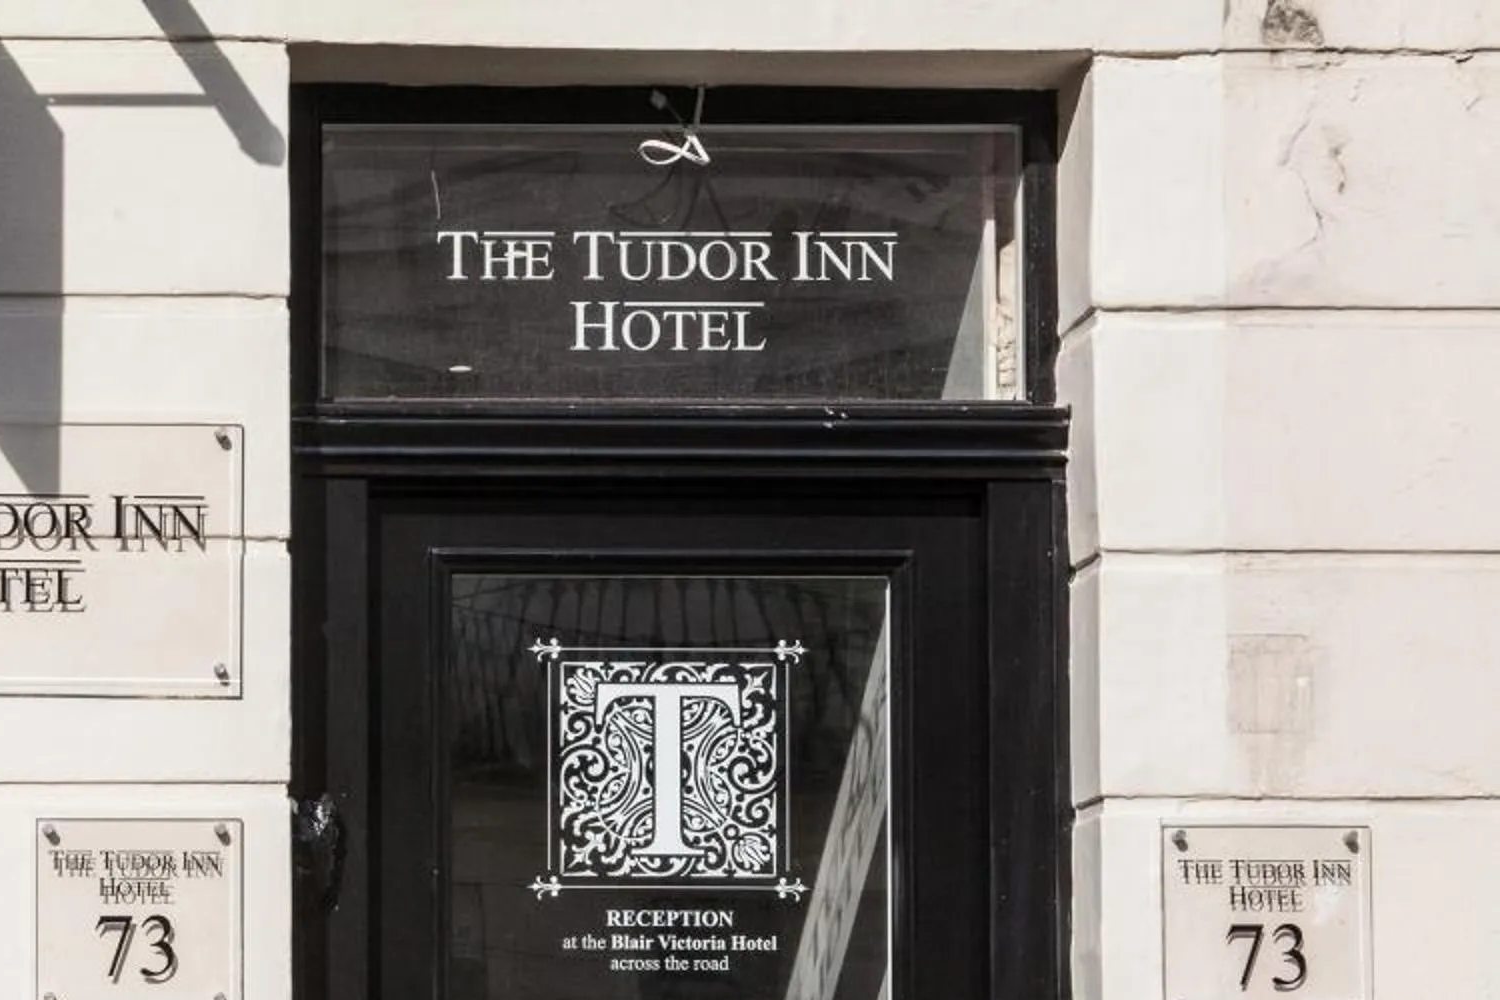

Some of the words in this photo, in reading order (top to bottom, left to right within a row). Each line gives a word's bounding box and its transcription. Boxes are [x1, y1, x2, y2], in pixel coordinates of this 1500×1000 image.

[437, 230, 555, 282] THE
[573, 230, 774, 282] TUDOR
[791, 230, 899, 282] INN
[569, 300, 766, 352] HOTEL
[112, 495, 208, 543] INN
[49, 850, 95, 872] THE
[100, 850, 177, 872] TUDOR
[182, 851, 221, 873] INN
[1177, 859, 1224, 880] THE
[1229, 859, 1306, 881] TUDOR
[1312, 859, 1352, 880] INN
[99, 877, 171, 898] HOTEL
[1230, 886, 1302, 907] HOTEL
[606, 909, 734, 929] RECEPTION
[95, 914, 175, 977] 73
[562, 935, 577, 951] at
[581, 934, 606, 951] the
[610, 934, 655, 951] Blair
[659, 934, 727, 952] Victoria
[731, 935, 777, 952] Hotel
[1225, 923, 1307, 985] 73
[610, 957, 660, 972] across
[664, 955, 690, 972] the
[693, 955, 729, 972] road
